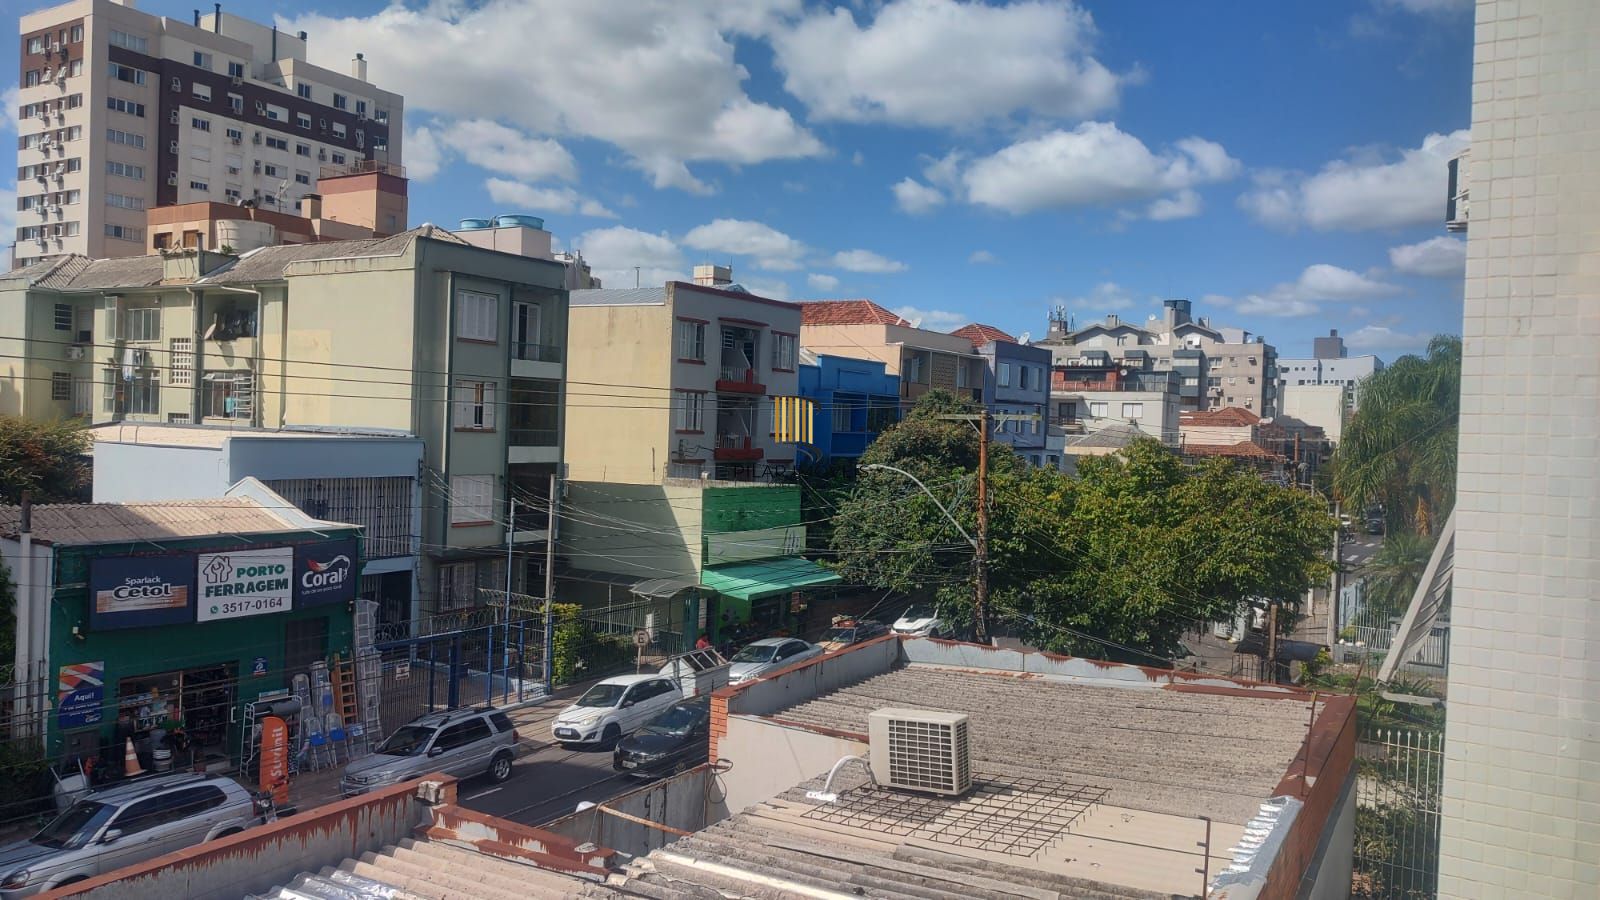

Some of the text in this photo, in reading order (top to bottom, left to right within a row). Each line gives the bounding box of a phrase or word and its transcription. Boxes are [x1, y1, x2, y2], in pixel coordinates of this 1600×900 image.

[236, 564, 285, 578] PORTO
[302, 568, 343, 588] Coral
[125, 576, 161, 586] Sparlack
[205, 578, 288, 598] FERRAGEM
[112, 583, 171, 601] Cetol
[222, 597, 282, 614] 3517-0164
[74, 691, 95, 702] Aqui!
[270, 726, 284, 777] Suvinil
